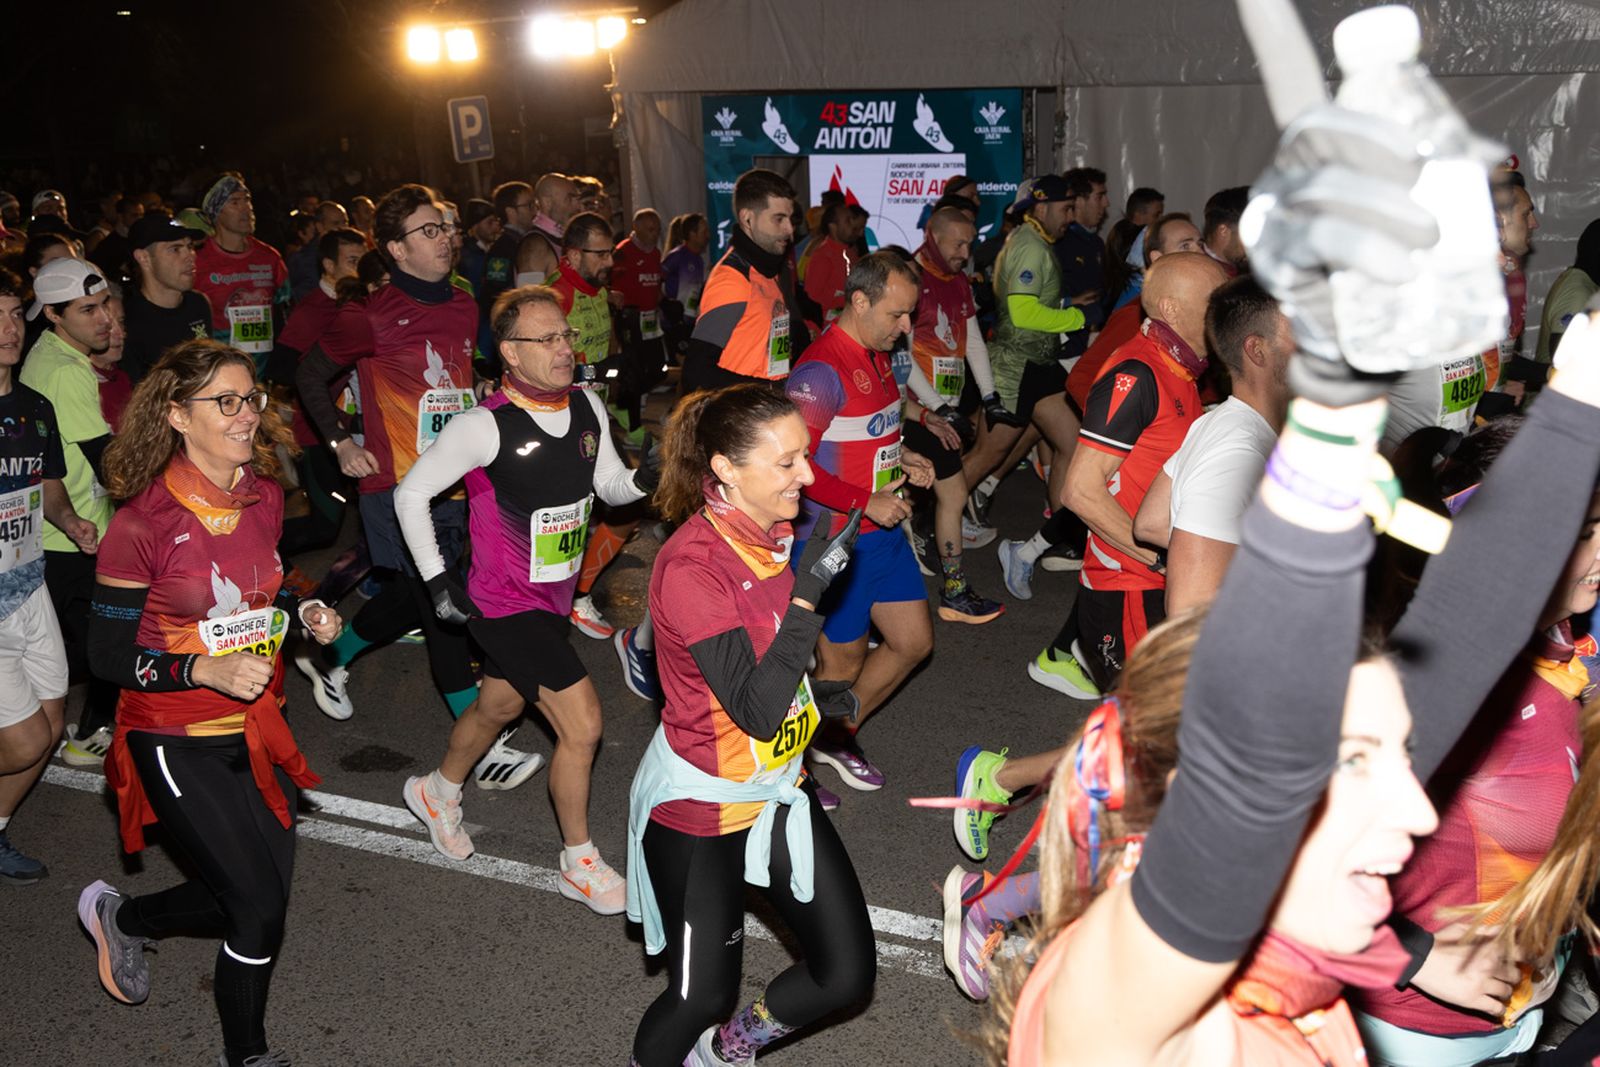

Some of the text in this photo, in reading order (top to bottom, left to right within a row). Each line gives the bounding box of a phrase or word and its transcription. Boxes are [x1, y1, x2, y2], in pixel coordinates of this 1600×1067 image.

[820, 101, 896, 127] 43 SAN
[458, 105, 482, 154] P
[814, 121, 893, 149] ANTÓN
[925, 126, 940, 143] 43
[773, 129, 788, 145] 43
[708, 181, 736, 190] calde
[888, 179, 924, 196] SAN
[976, 181, 1017, 191] alderón
[427, 404, 442, 413] SAN
[0, 499, 17, 510] OCHE
[552, 512, 573, 523] NOCHE
[541, 524, 558, 534] SAN
[227, 618, 267, 635] NOCHE DE
[216, 637, 236, 650] SAN
